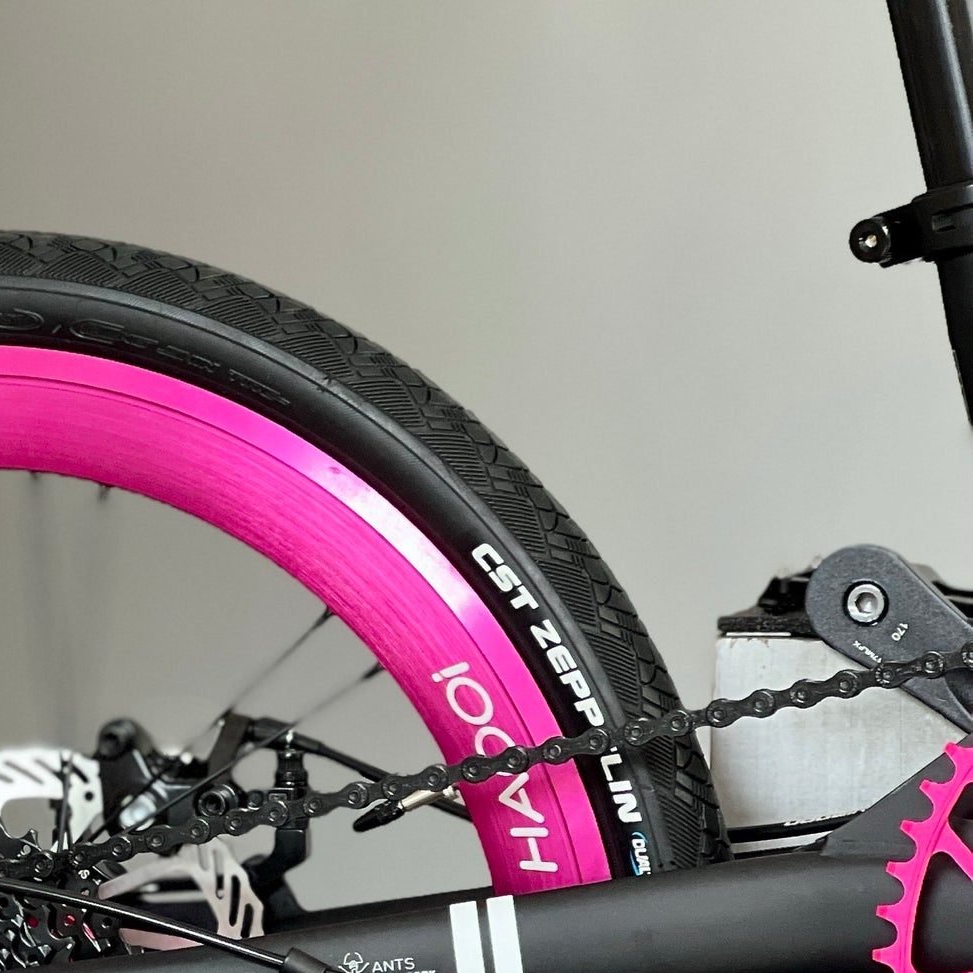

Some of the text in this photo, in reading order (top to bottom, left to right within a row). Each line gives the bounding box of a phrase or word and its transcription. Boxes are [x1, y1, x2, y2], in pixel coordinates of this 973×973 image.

[891, 623, 909, 641] 170
[471, 543, 642, 824] CST ZEPPLIN
[631, 837, 651, 875] DUAL
[372, 957, 415, 973] ANTS
